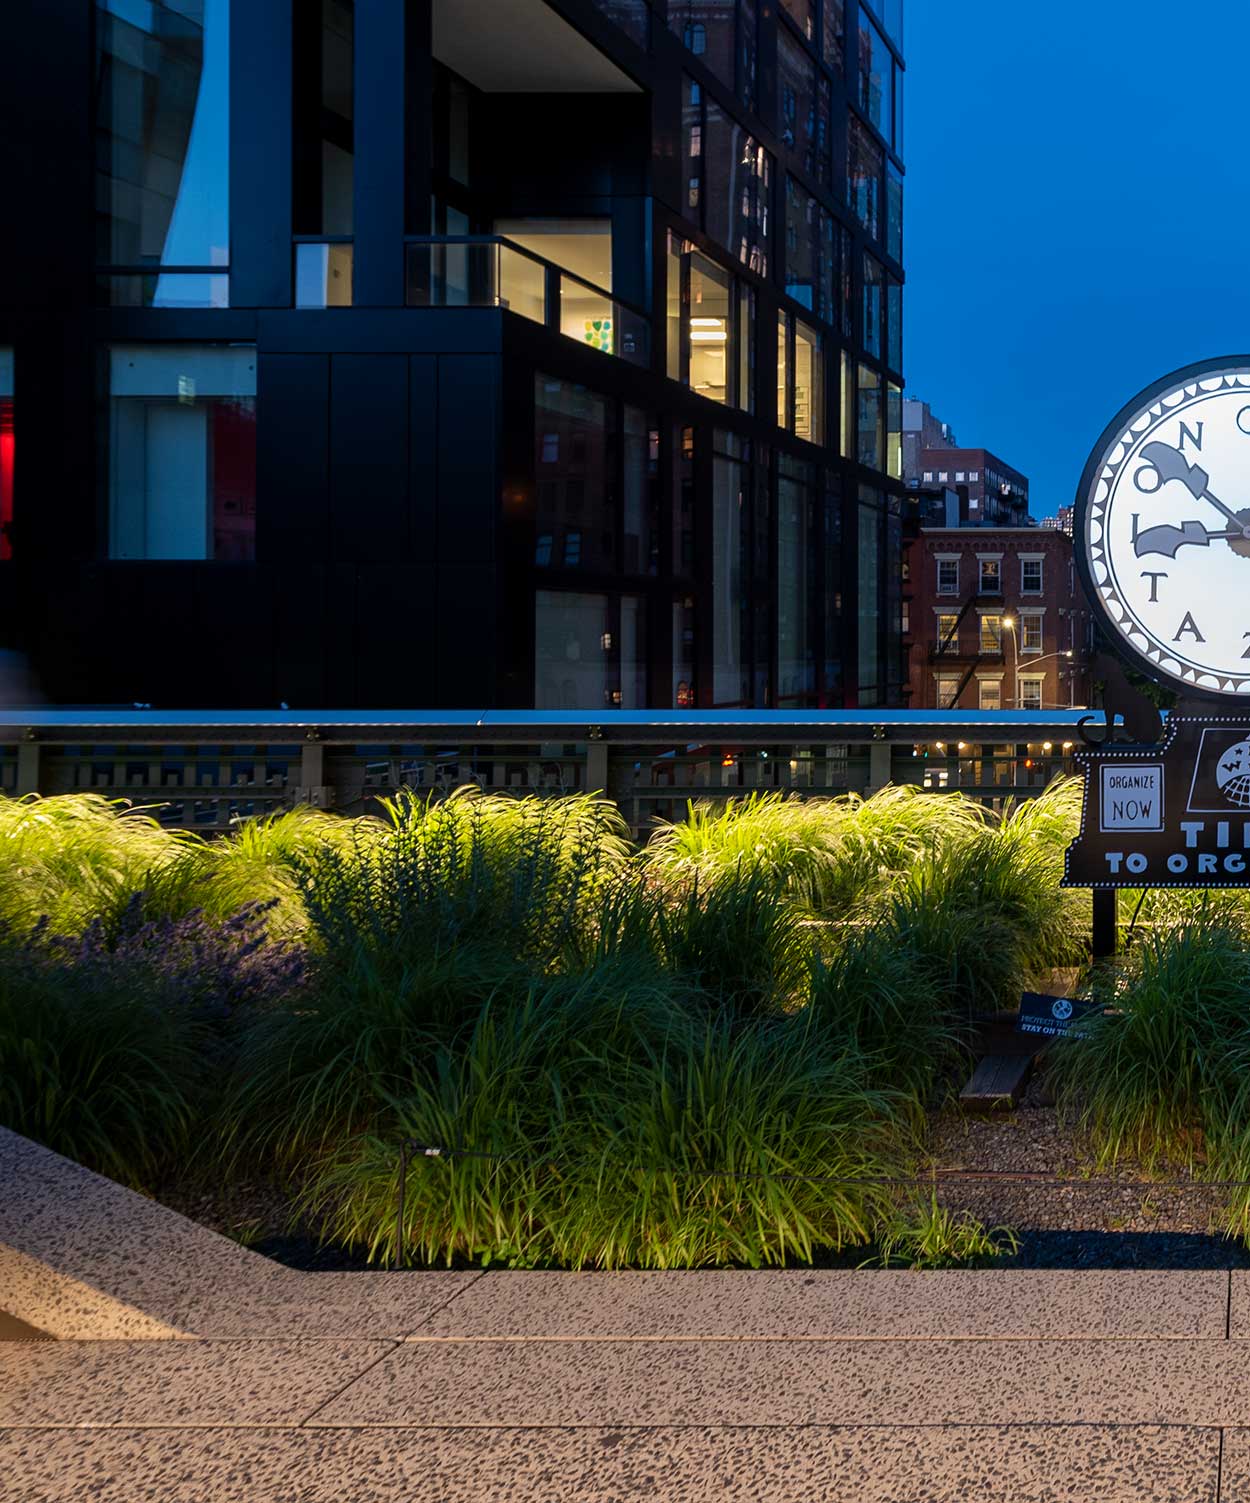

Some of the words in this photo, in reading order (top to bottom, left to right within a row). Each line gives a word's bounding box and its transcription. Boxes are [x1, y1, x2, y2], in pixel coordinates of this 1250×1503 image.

[1109, 775, 1154, 789] ORGANIZE
[1112, 800, 1152, 820] NOW
[1105, 852, 1148, 874] TO
[1021, 1023, 1042, 1033] STAY
[1042, 1026, 1055, 1034] ON
